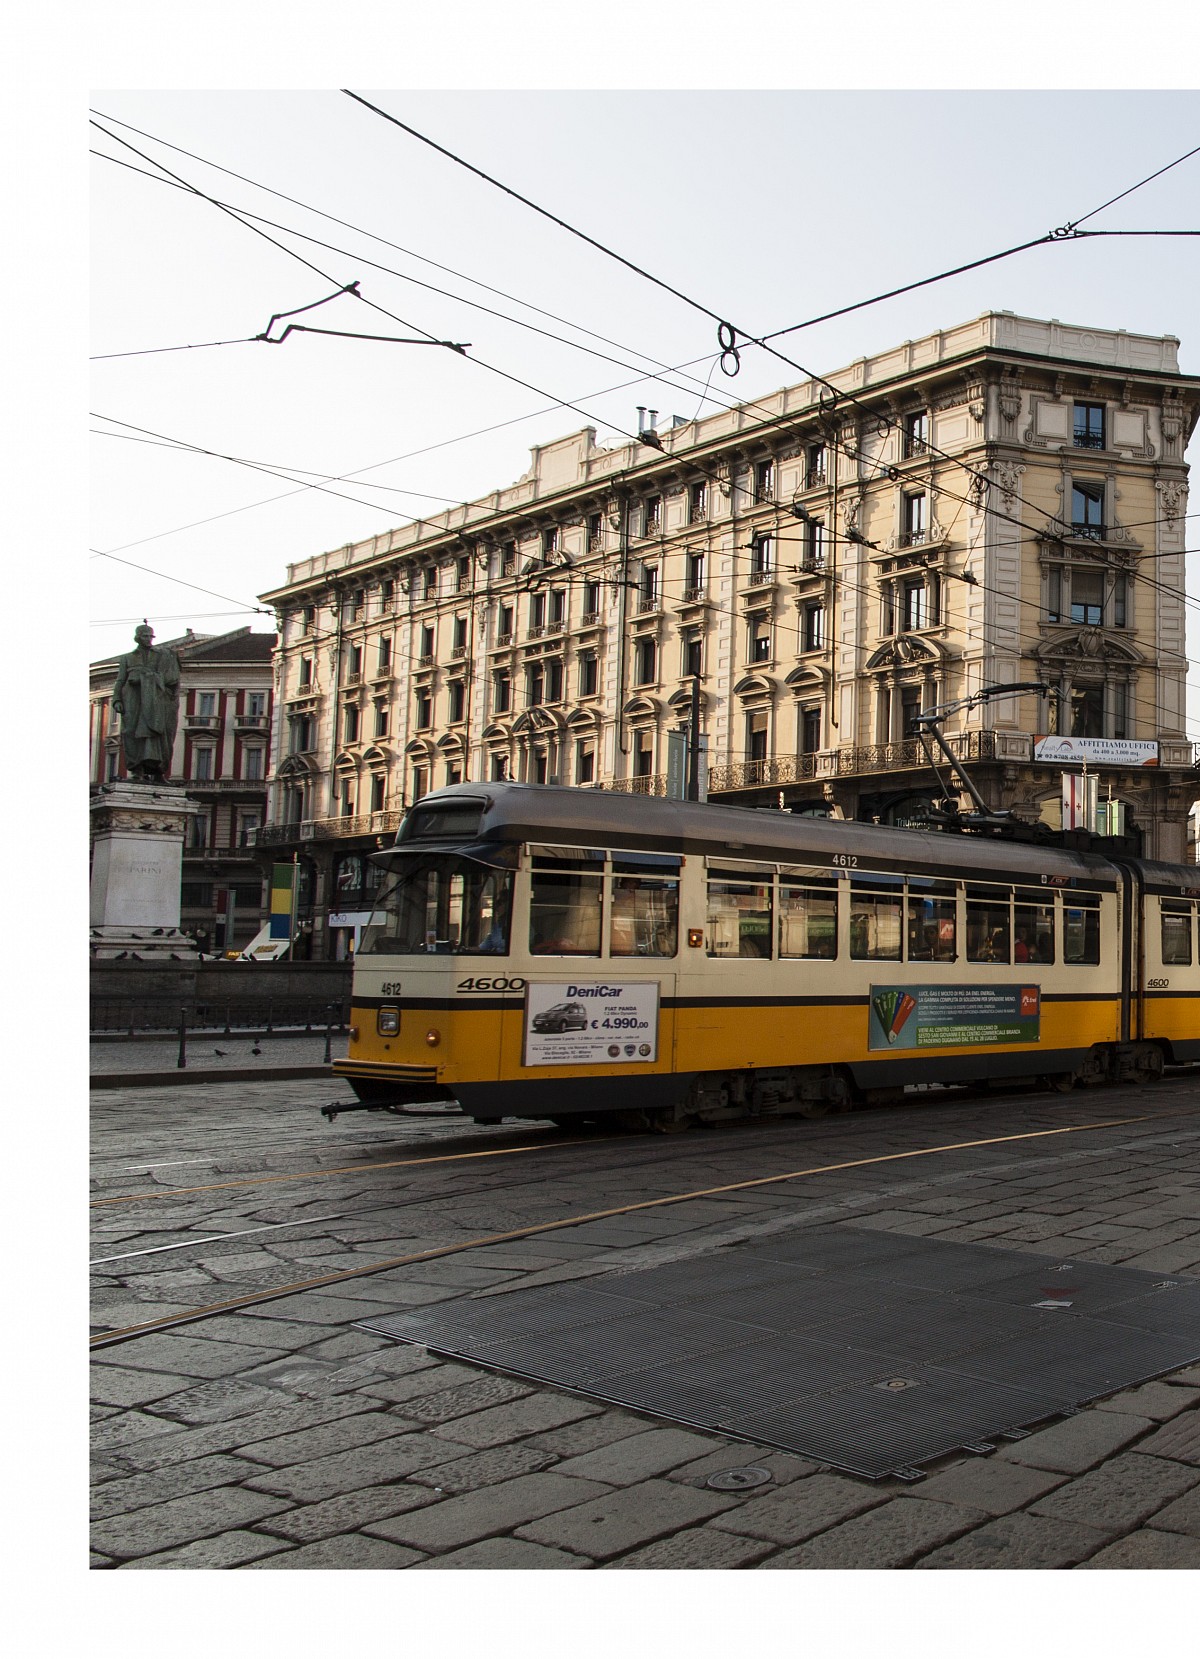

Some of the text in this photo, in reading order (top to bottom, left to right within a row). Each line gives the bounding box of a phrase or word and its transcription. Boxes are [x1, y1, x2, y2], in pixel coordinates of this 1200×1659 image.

[1078, 740, 1155, 750] AFFITTIAMO UFFICI
[832, 854, 858, 868] 4612
[457, 978, 525, 990] 4600
[1147, 978, 1170, 987] 4600
[381, 982, 402, 996] 4612
[566, 986, 623, 998] DeniCar
[591, 1017, 649, 1030] € 4.990,00
